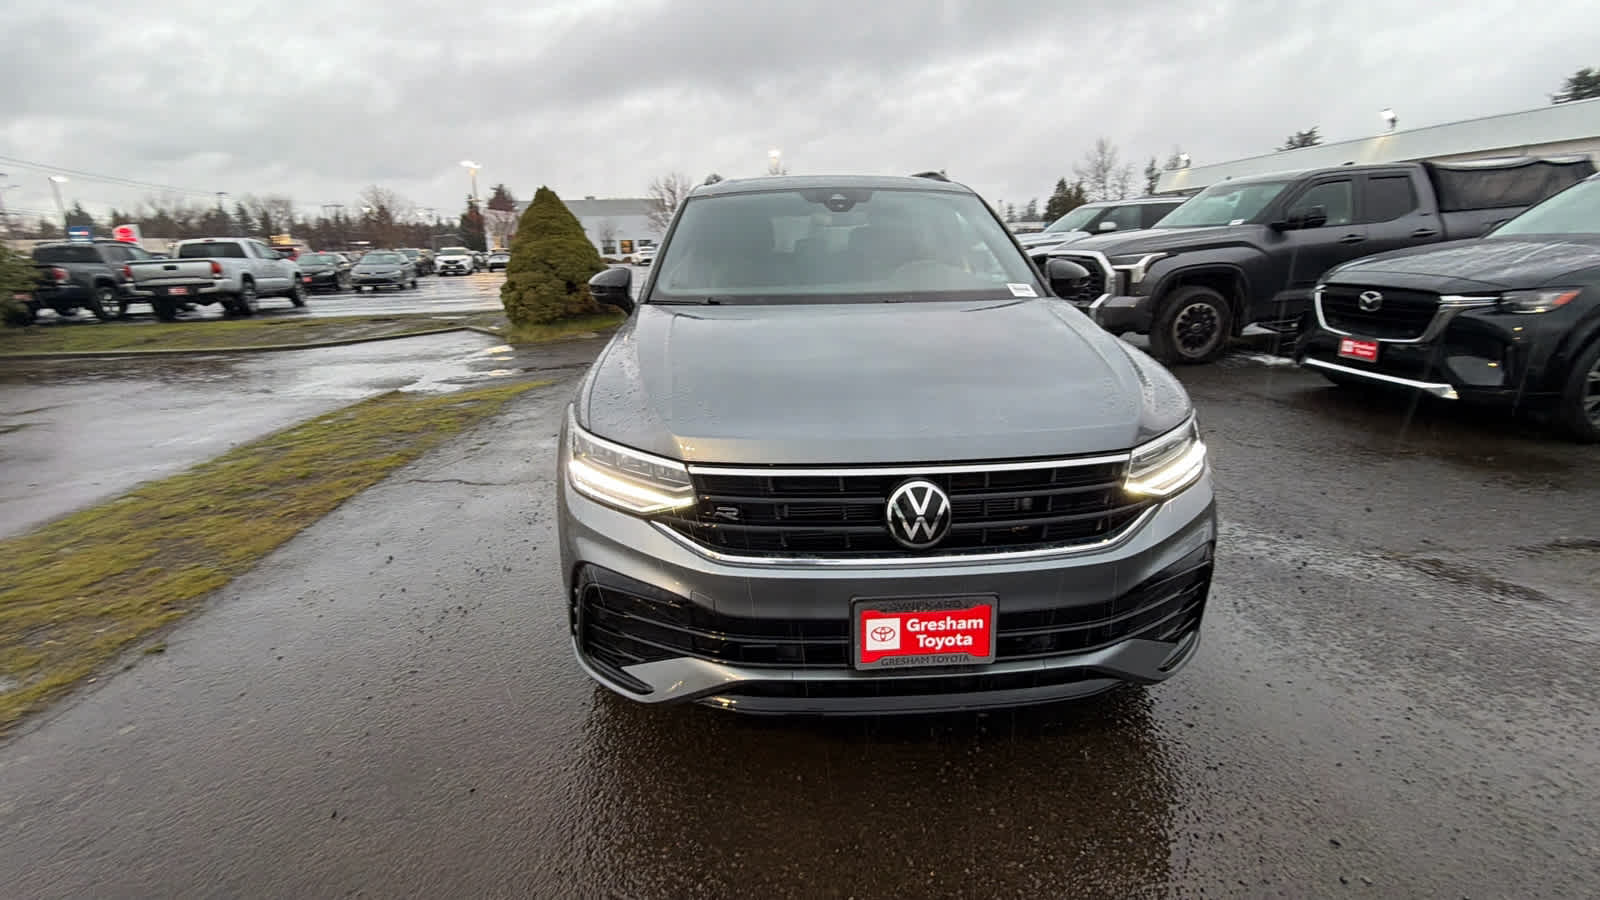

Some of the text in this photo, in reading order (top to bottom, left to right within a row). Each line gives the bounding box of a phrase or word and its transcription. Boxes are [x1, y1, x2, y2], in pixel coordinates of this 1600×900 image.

[906, 616, 984, 632] Gresham
[916, 633, 973, 650] Toyota
[880, 654, 969, 666] GRESHAM TOYOTA
